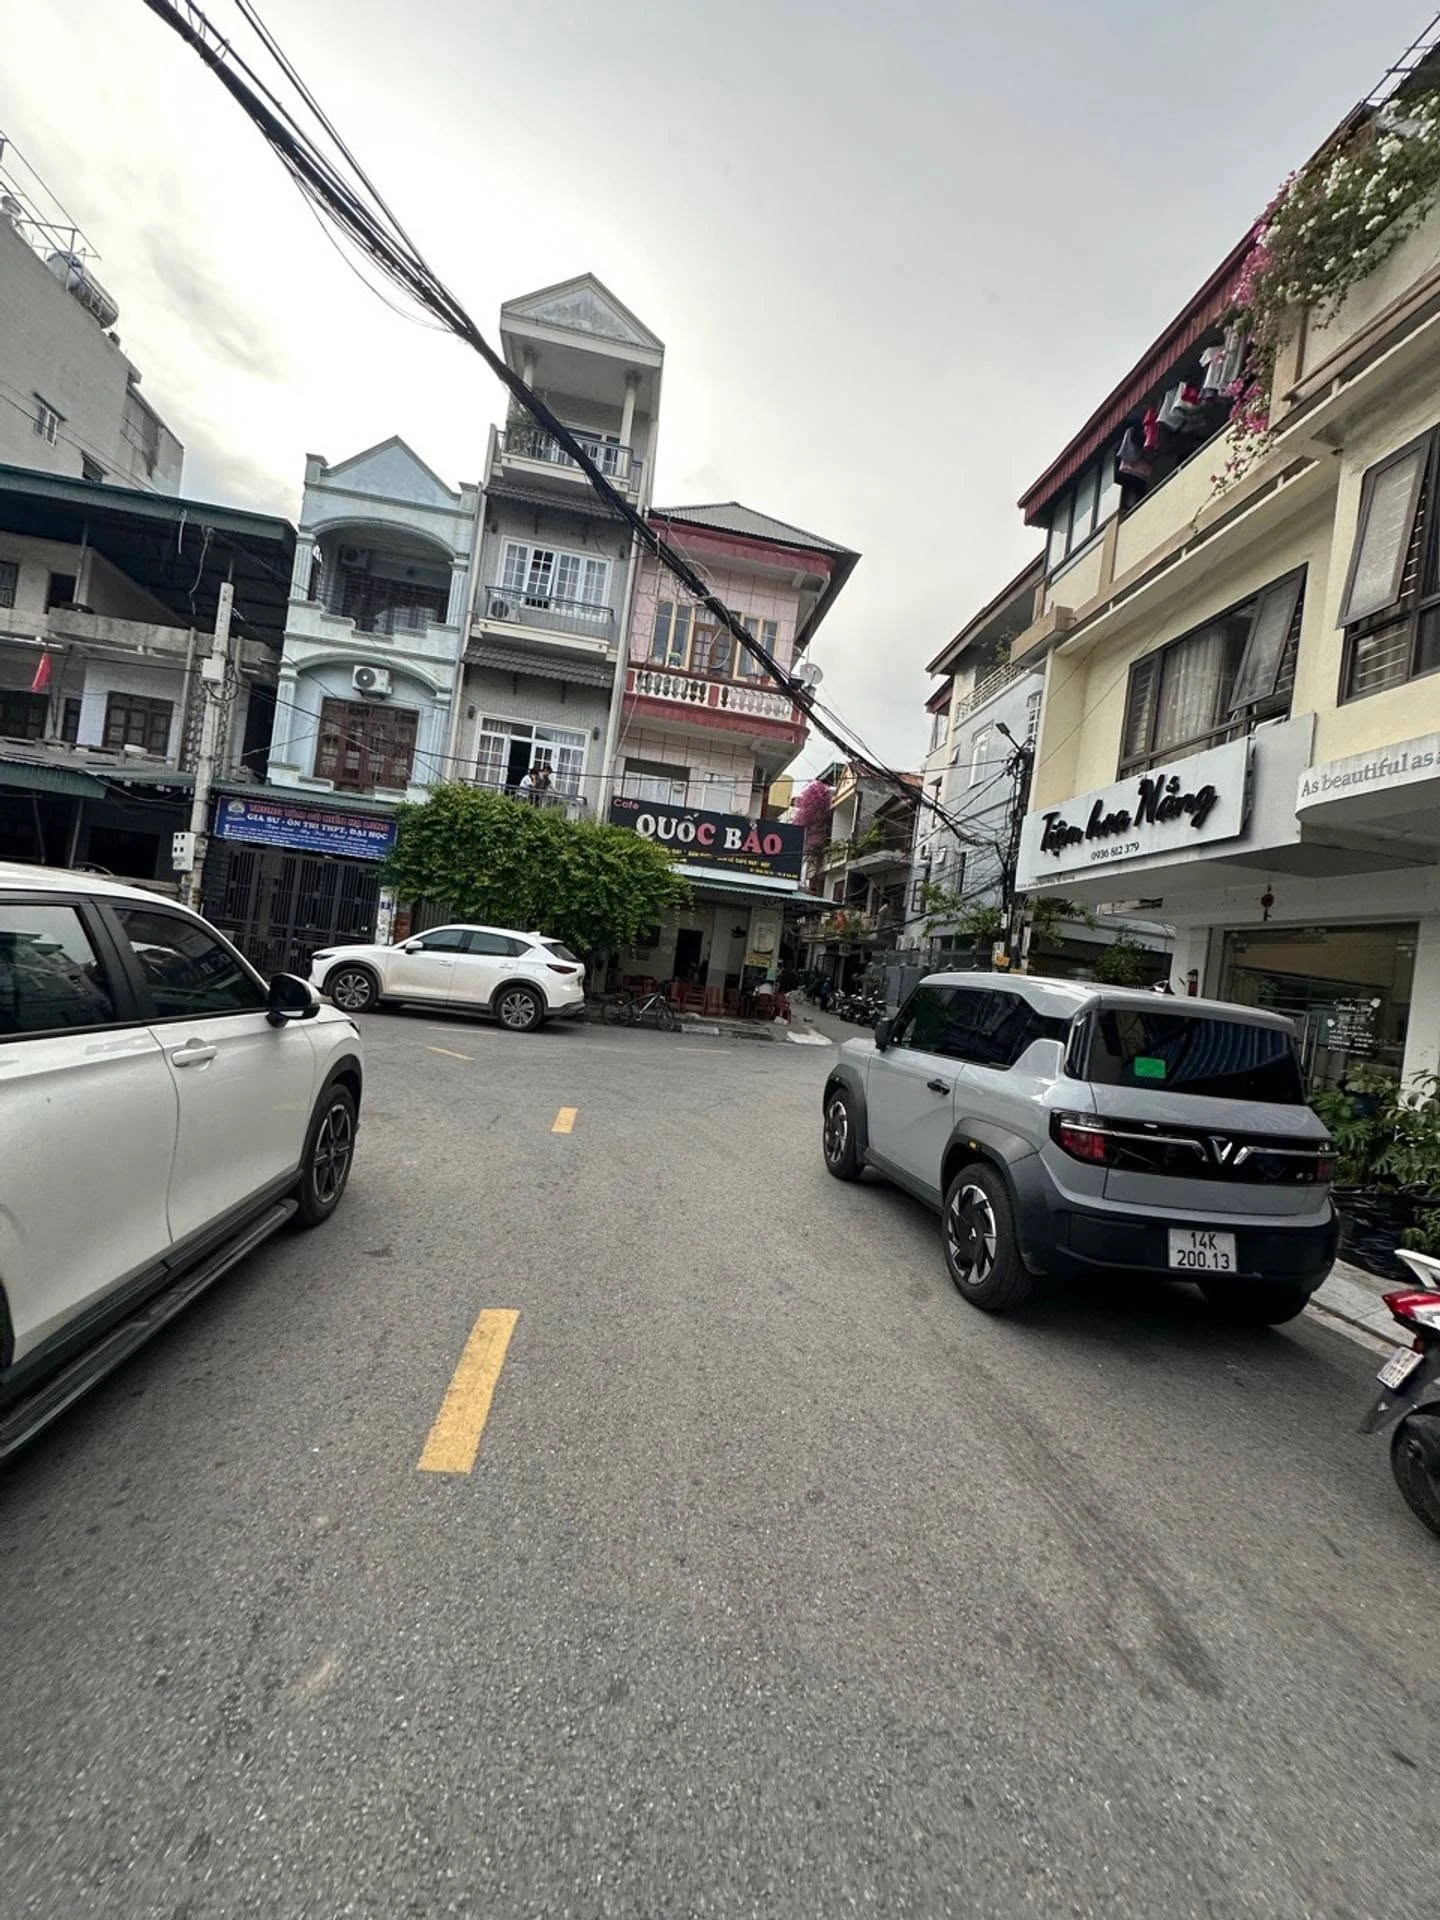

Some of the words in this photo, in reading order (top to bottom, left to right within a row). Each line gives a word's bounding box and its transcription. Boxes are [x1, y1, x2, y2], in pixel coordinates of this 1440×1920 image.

[1301, 779, 1319, 797] As
[1322, 752, 1409, 791] beautiful
[1411, 751, 1434, 771] as
[636, 813, 717, 846] QUỐC
[723, 823, 783, 856] BẢO
[1040, 811, 1084, 858] Tiệm
[1176, 1249, 1231, 1270] 200.13
[1190, 1231, 1218, 1250] 14K
